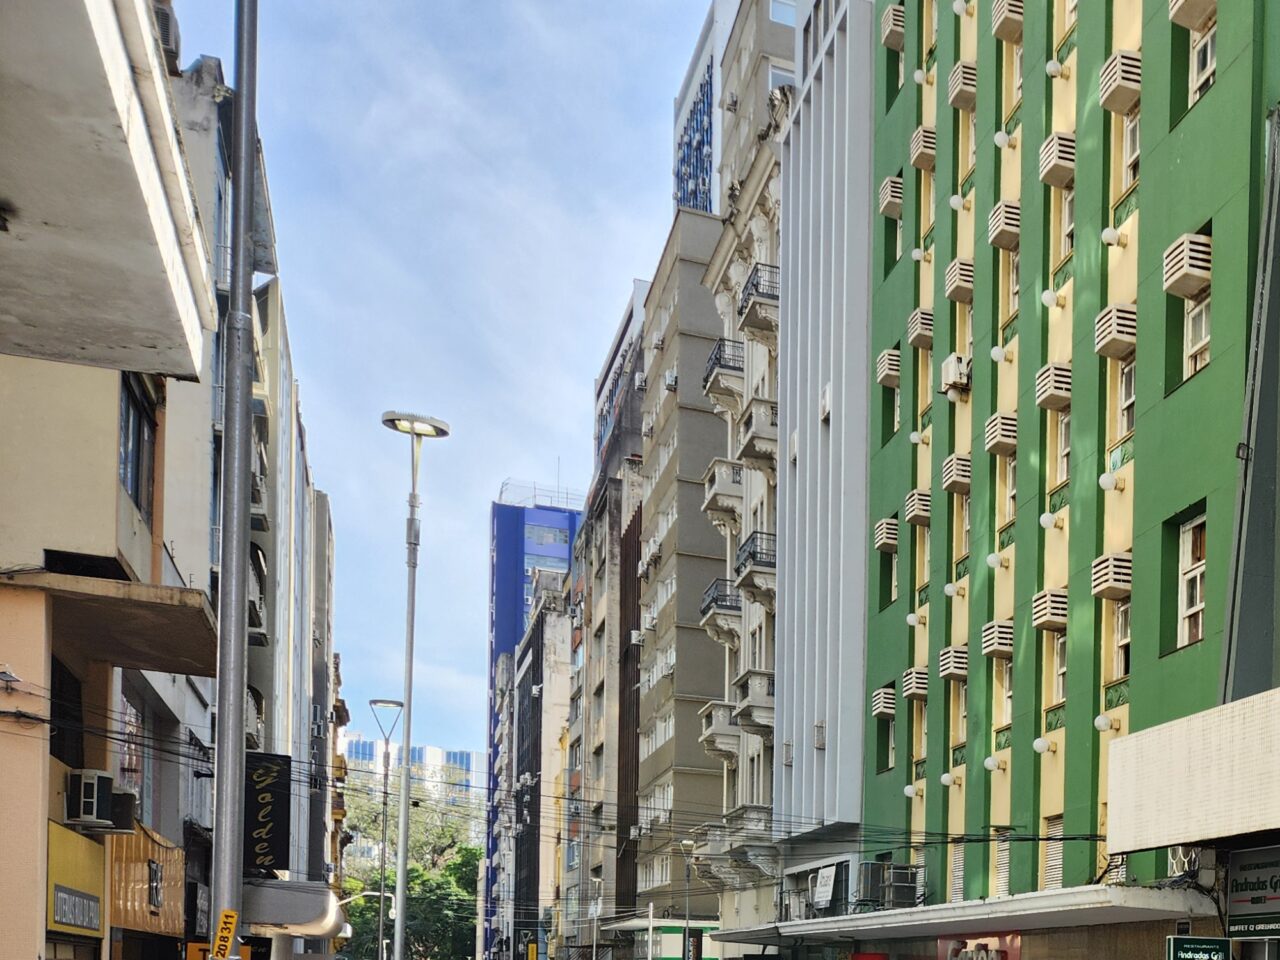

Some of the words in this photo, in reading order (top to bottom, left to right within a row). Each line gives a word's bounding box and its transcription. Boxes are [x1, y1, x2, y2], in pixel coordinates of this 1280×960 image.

[252, 762, 286, 866] Golden
[1230, 876, 1268, 893] Andradas
[1230, 924, 1248, 932] BUFFET
[1177, 951, 1210, 960] Andradas
